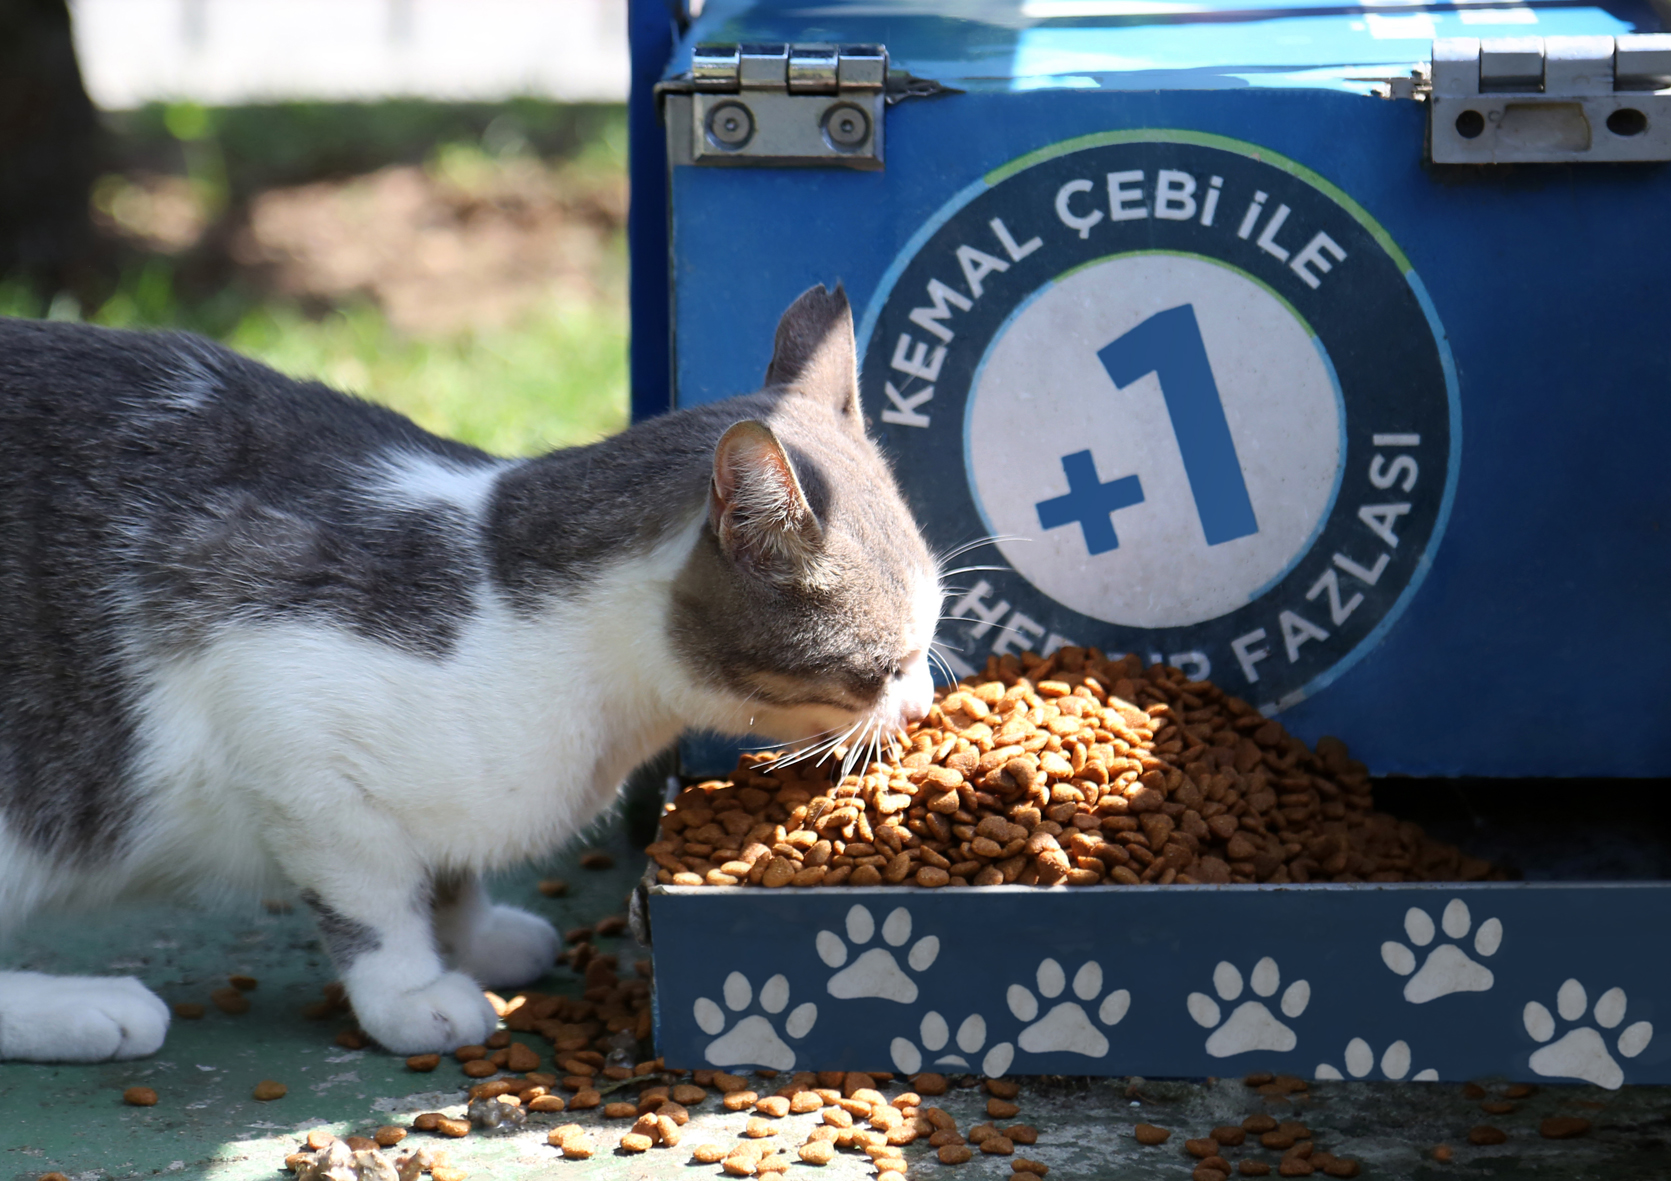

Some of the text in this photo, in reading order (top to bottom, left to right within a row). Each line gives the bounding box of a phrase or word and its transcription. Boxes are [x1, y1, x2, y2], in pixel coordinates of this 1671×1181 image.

[881, 216, 1043, 428] KEMAL
[1036, 303, 1259, 556] +1
[1231, 433, 1421, 684] FAZLASI
